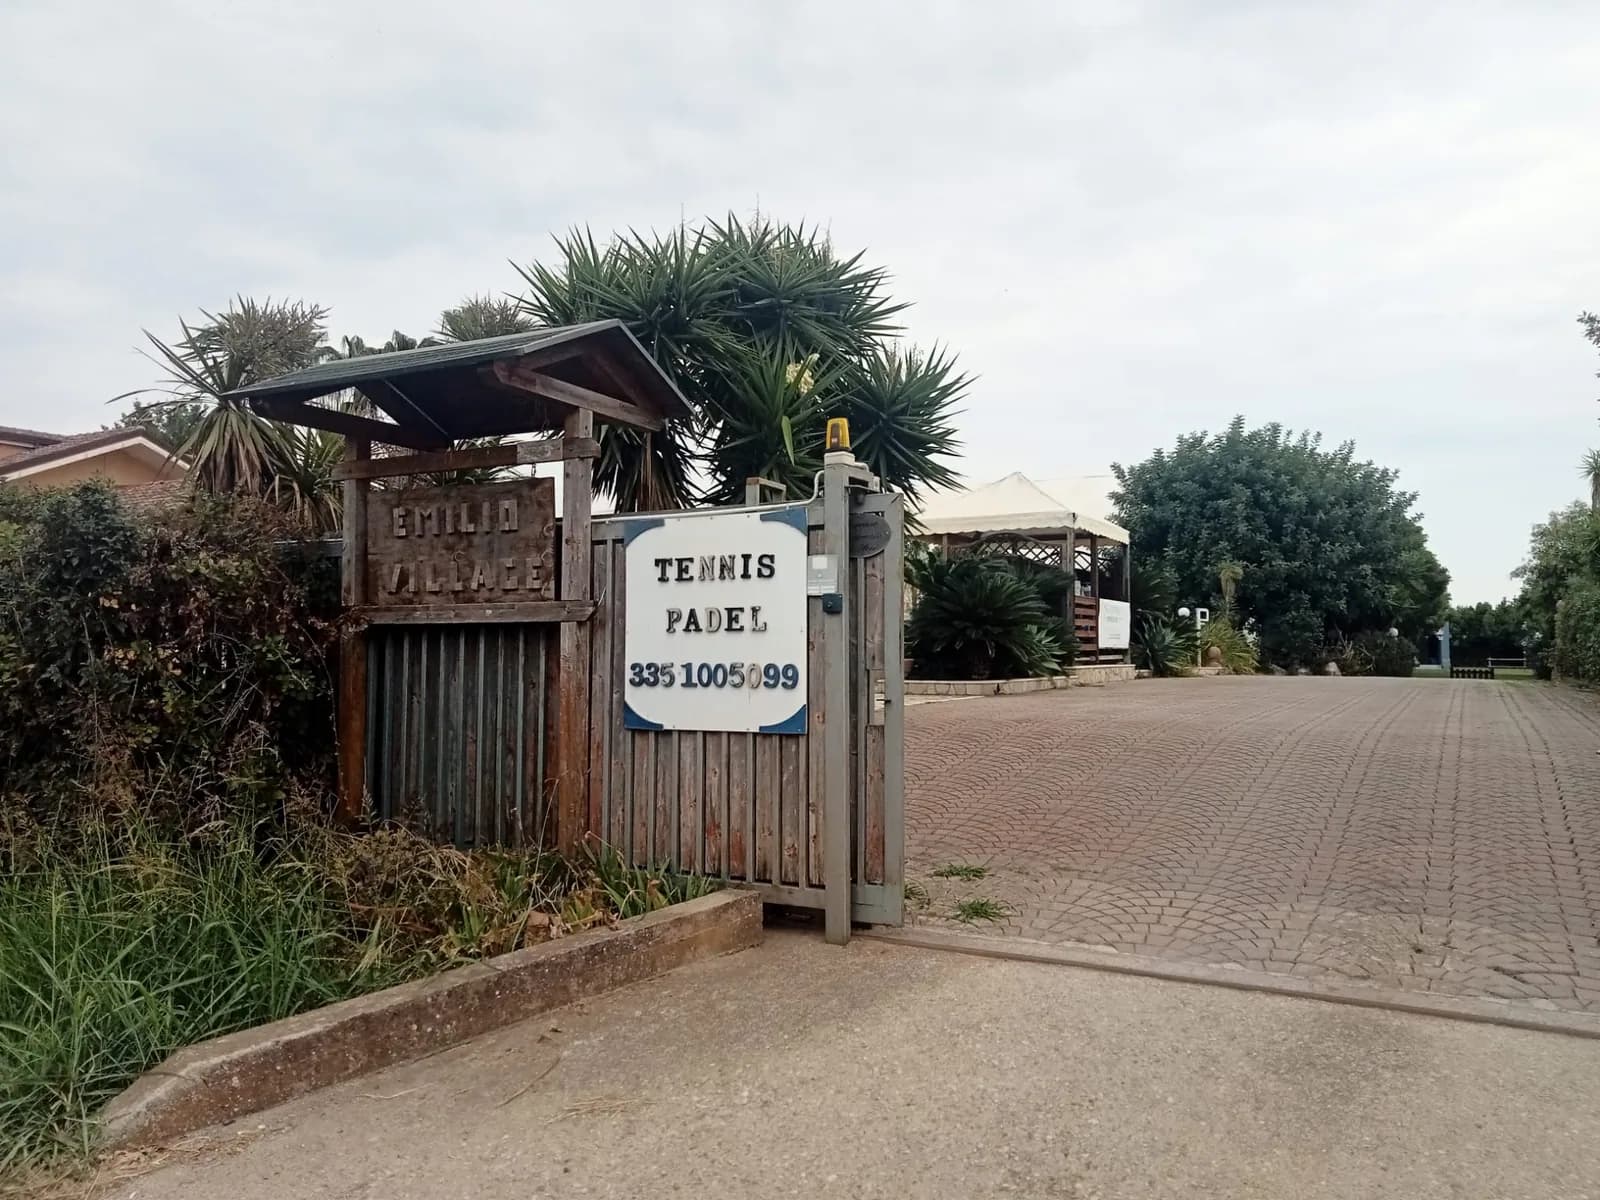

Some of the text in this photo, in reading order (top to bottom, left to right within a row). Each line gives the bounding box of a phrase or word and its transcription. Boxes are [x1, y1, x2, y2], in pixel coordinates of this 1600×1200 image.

[392, 499, 519, 536] EMILIO
[655, 553, 776, 582] TENNIS
[666, 605, 767, 633] PADEL
